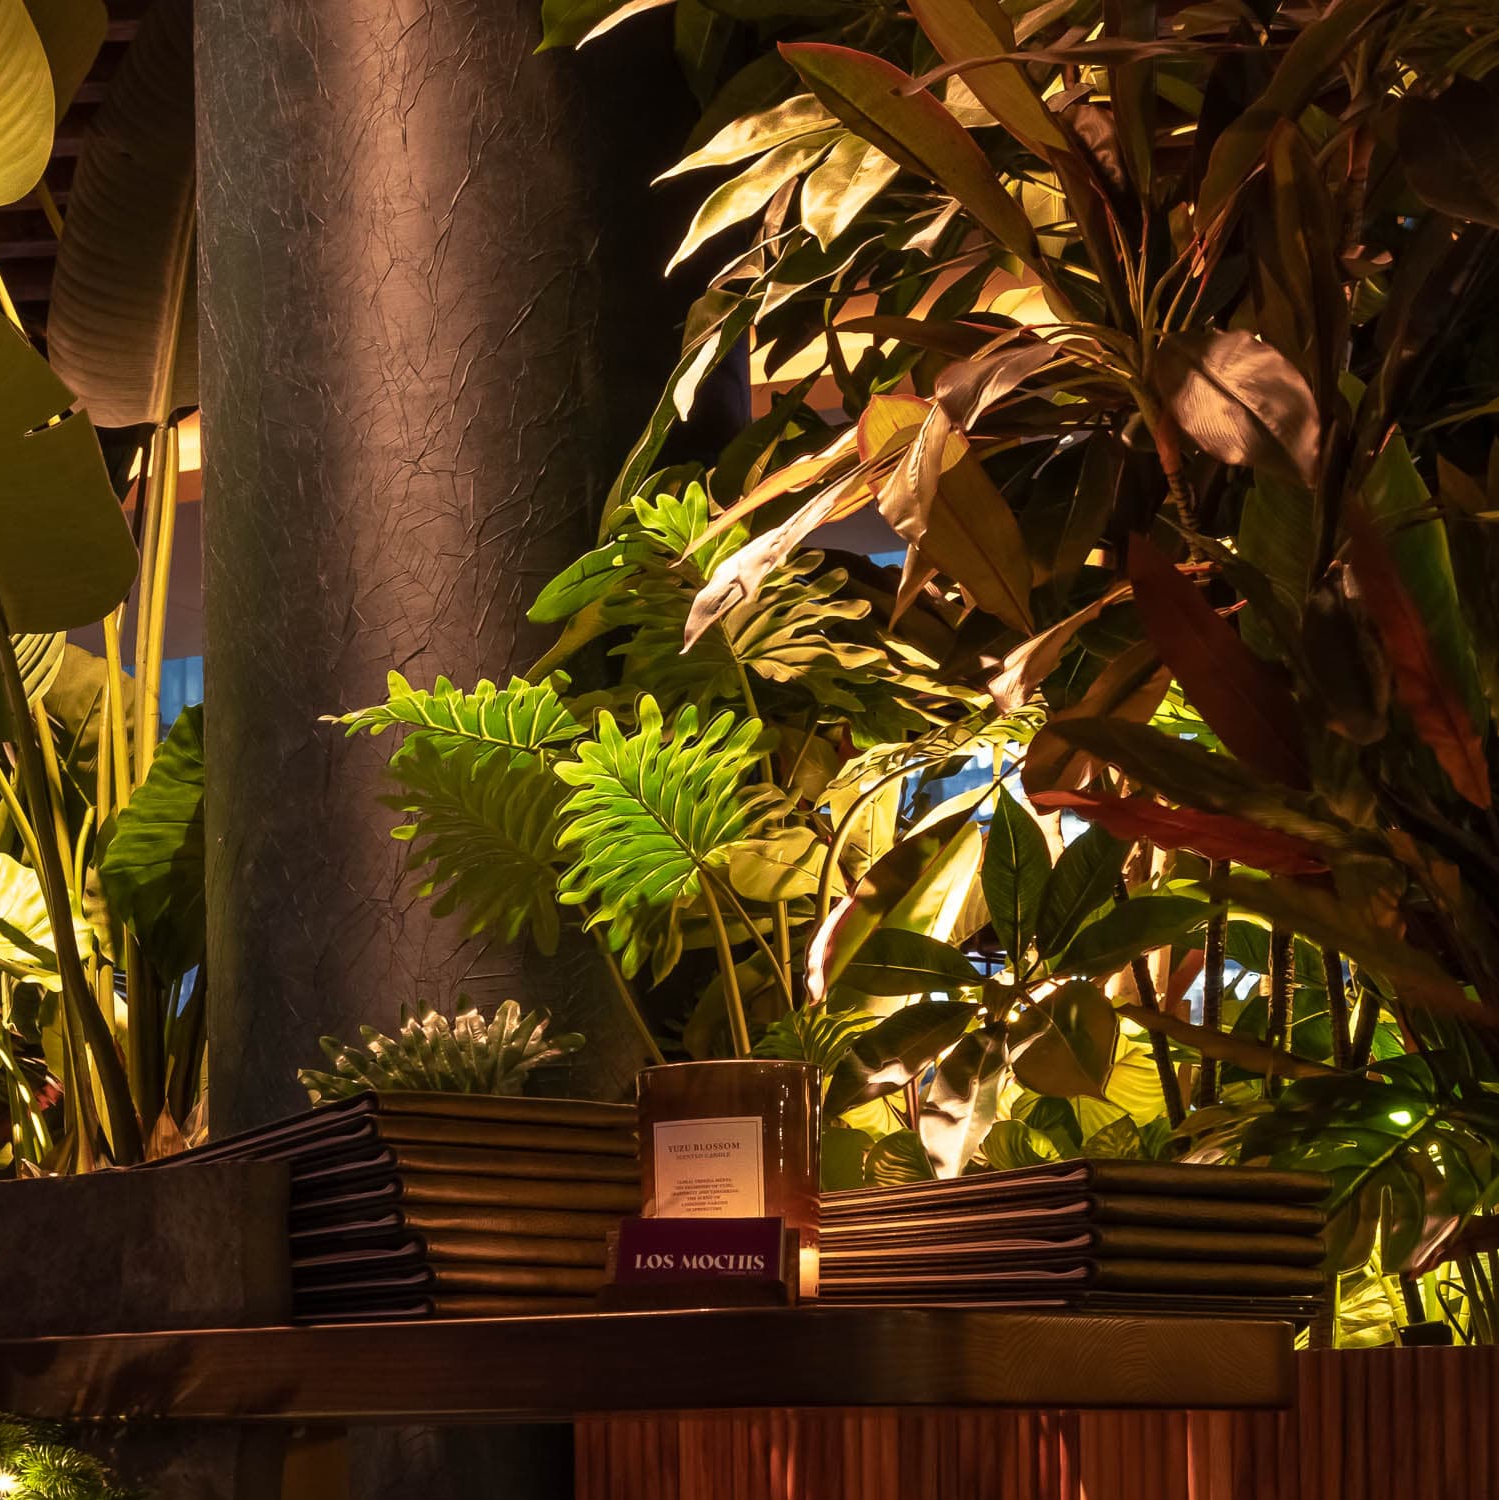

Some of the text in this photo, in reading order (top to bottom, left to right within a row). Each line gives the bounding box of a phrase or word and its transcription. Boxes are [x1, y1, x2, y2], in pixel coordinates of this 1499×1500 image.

[667, 1141, 740, 1153] YUZU BLOSSOM
[635, 1253, 765, 1271] LOS MOCHIS
